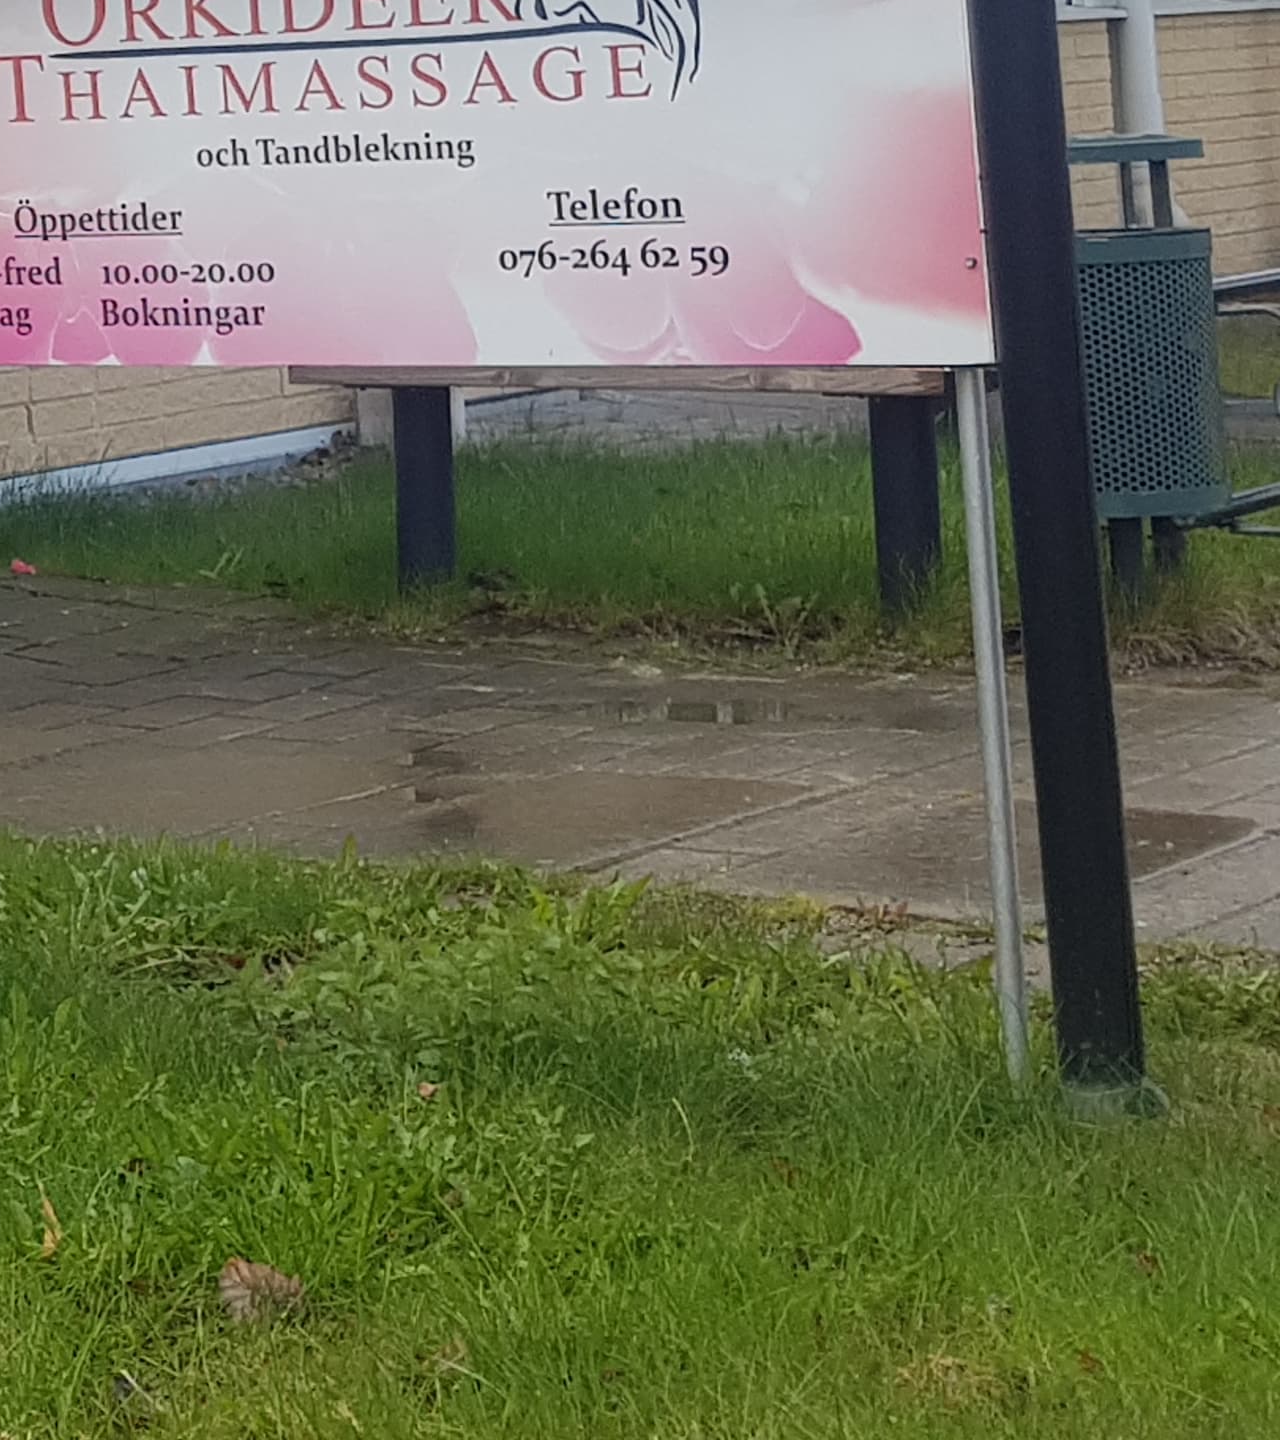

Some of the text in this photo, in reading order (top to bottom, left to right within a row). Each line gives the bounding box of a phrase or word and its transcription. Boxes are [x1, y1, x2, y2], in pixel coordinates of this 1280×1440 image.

[196, 132, 476, 168] och Tandblekning
[13, 199, 183, 241] Öppettider
[546, 187, 686, 221] Telefon
[100, 261, 276, 286] 10.00-20.00
[498, 237, 730, 279] 076-264 62 59
[100, 296, 266, 336] Bokningar
